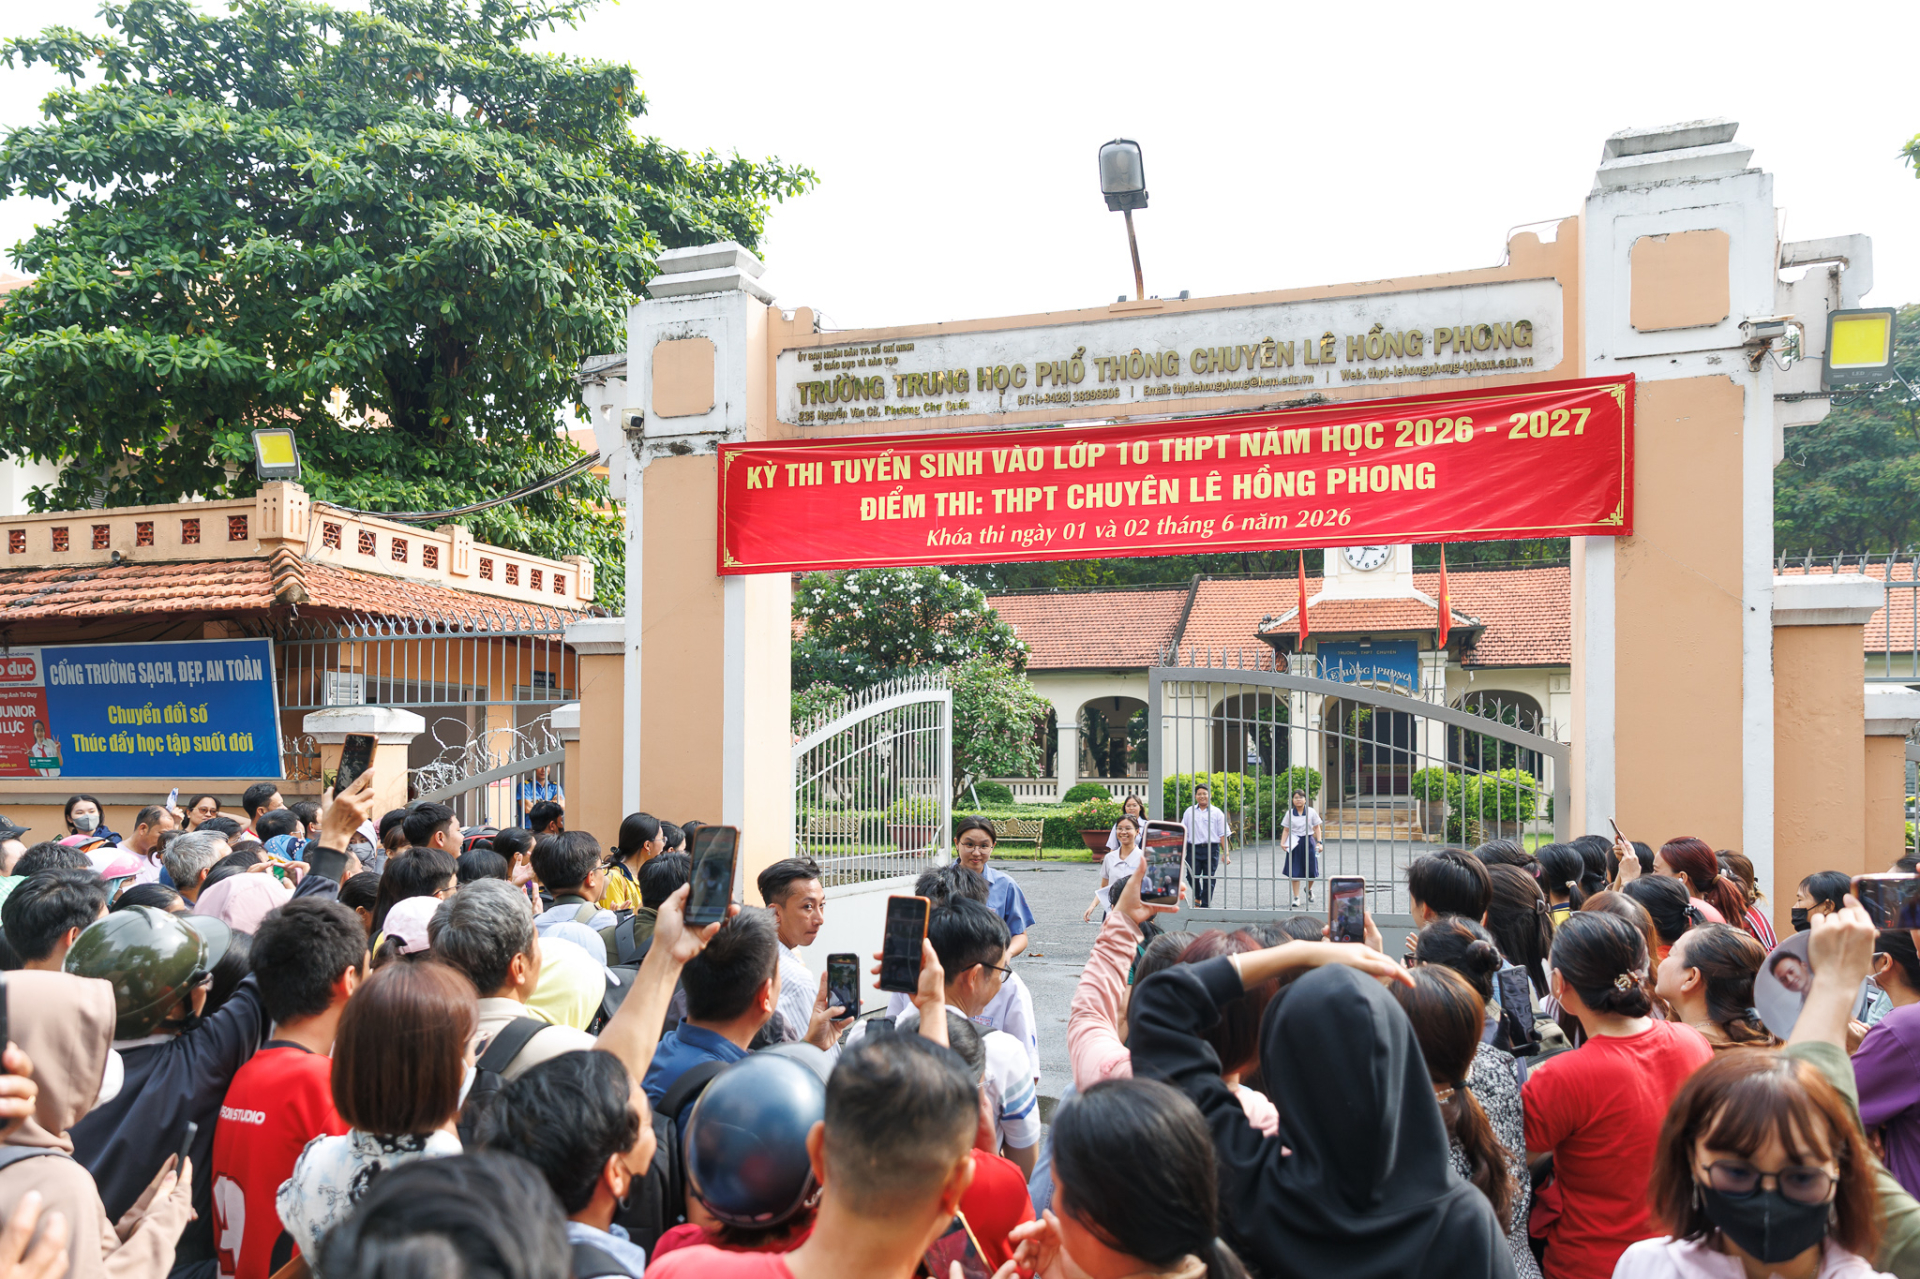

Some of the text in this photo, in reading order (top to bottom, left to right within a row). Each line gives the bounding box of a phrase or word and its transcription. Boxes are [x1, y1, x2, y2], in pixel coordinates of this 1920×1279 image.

[796, 318, 1534, 406] TRƯỜNG TRUNG HỌC PHỔ THÔNG CHUYÊN LÊ HỒNG PHONG
[808, 352, 823, 361] BAN
[824, 348, 843, 360] NHÂN
[844, 347, 858, 357] DÂN
[882, 342, 895, 354] CHÍ
[896, 342, 915, 352] MINH
[824, 360, 841, 371] GIÁO
[841, 360, 856, 370] DỤC
[856, 358, 866, 368] VÀ
[868, 356, 883, 366] ĐÀO
[884, 356, 899, 366] TẠO
[798, 410, 815, 422] 235
[817, 406, 848, 421] Nguyễn
[850, 406, 865, 418] Văn
[884, 404, 921, 416] Phường
[922, 402, 942, 413] Chợ
[944, 399, 970, 411] Quán
[1072, 387, 1121, 402] 38398506
[1143, 384, 1171, 397] Email:
[746, 407, 1592, 490] KỲ THI TUYỂN SINH VÀO LỚP 10 THPT NĂM HỌC 2026 - 2027
[860, 462, 1436, 522] ĐIỂM THI: THPT CHUYÊN LÊ HỒNG PHONG
[926, 507, 1352, 548] Khóa thi ngày 01 và 02 tháng 6 năm 2026
[7, 660, 34, 678] dục
[50, 654, 264, 688] CỔNG TRƯỜNG SẠCH, ĐẸP, AN TOÀN
[26, 691, 38, 699] Duy
[108, 701, 208, 726] Chuyển đổi số
[2, 720, 25, 738] LỰC
[72, 730, 254, 756] Thúc đẩy học tập suốt đời
